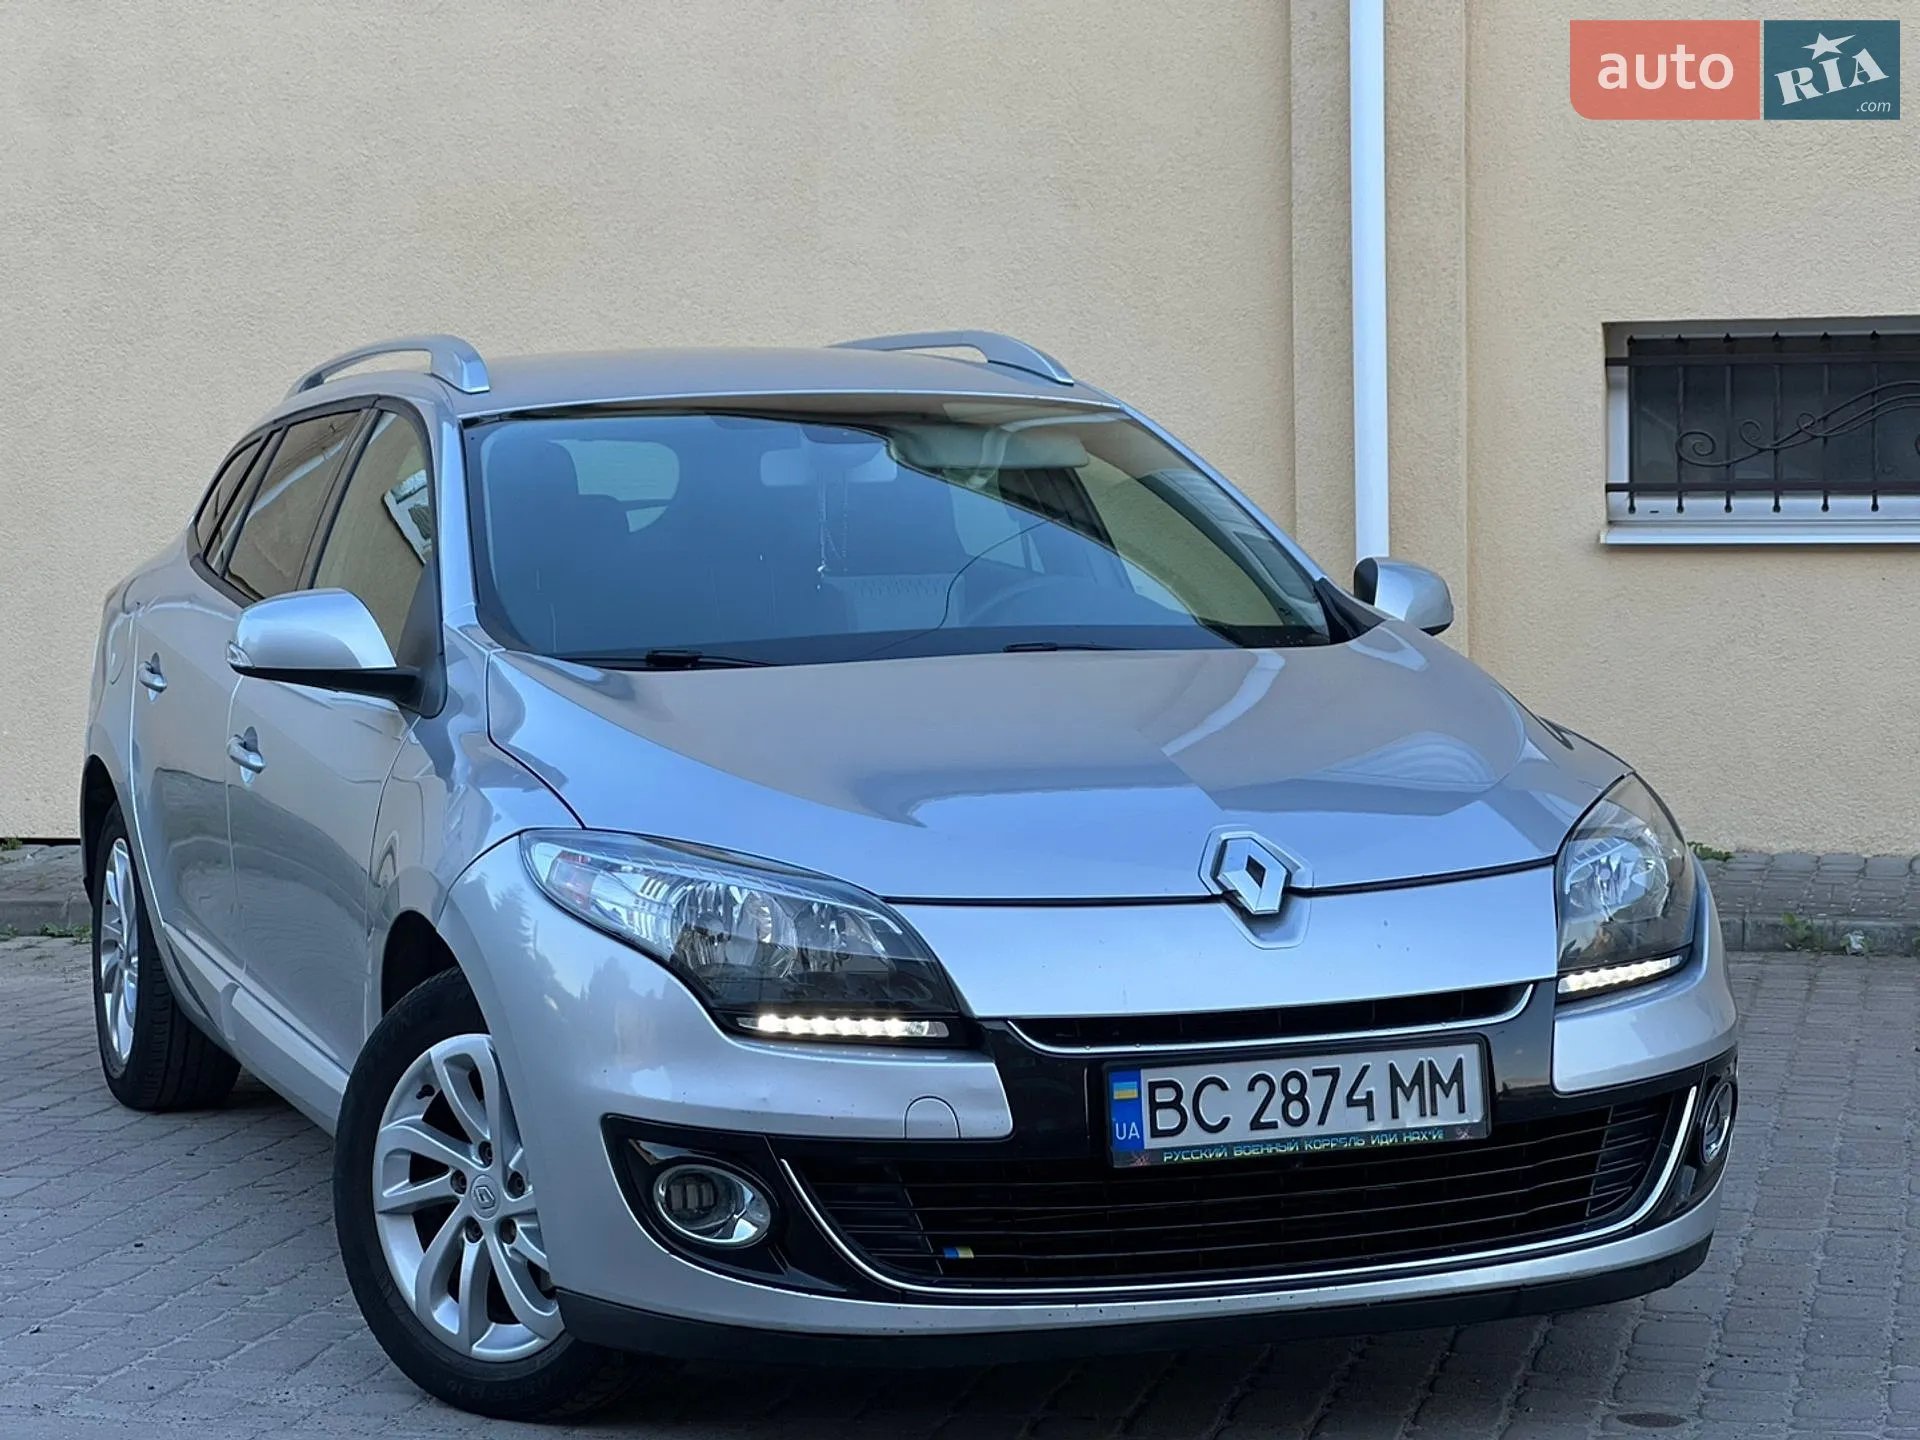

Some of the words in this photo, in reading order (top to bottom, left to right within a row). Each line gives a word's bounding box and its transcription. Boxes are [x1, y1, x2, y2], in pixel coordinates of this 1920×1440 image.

[1147, 1076, 1232, 1138] BC
[1247, 1062, 1375, 1131] 2874
[1388, 1055, 1466, 1120] MM
[1115, 1122, 1140, 1141] UA
[1164, 1145, 1228, 1163] РУССКИЙ
[1233, 1139, 1299, 1156] ВОЕННЫЙ
[1370, 1133, 1398, 1146] ИДИ
